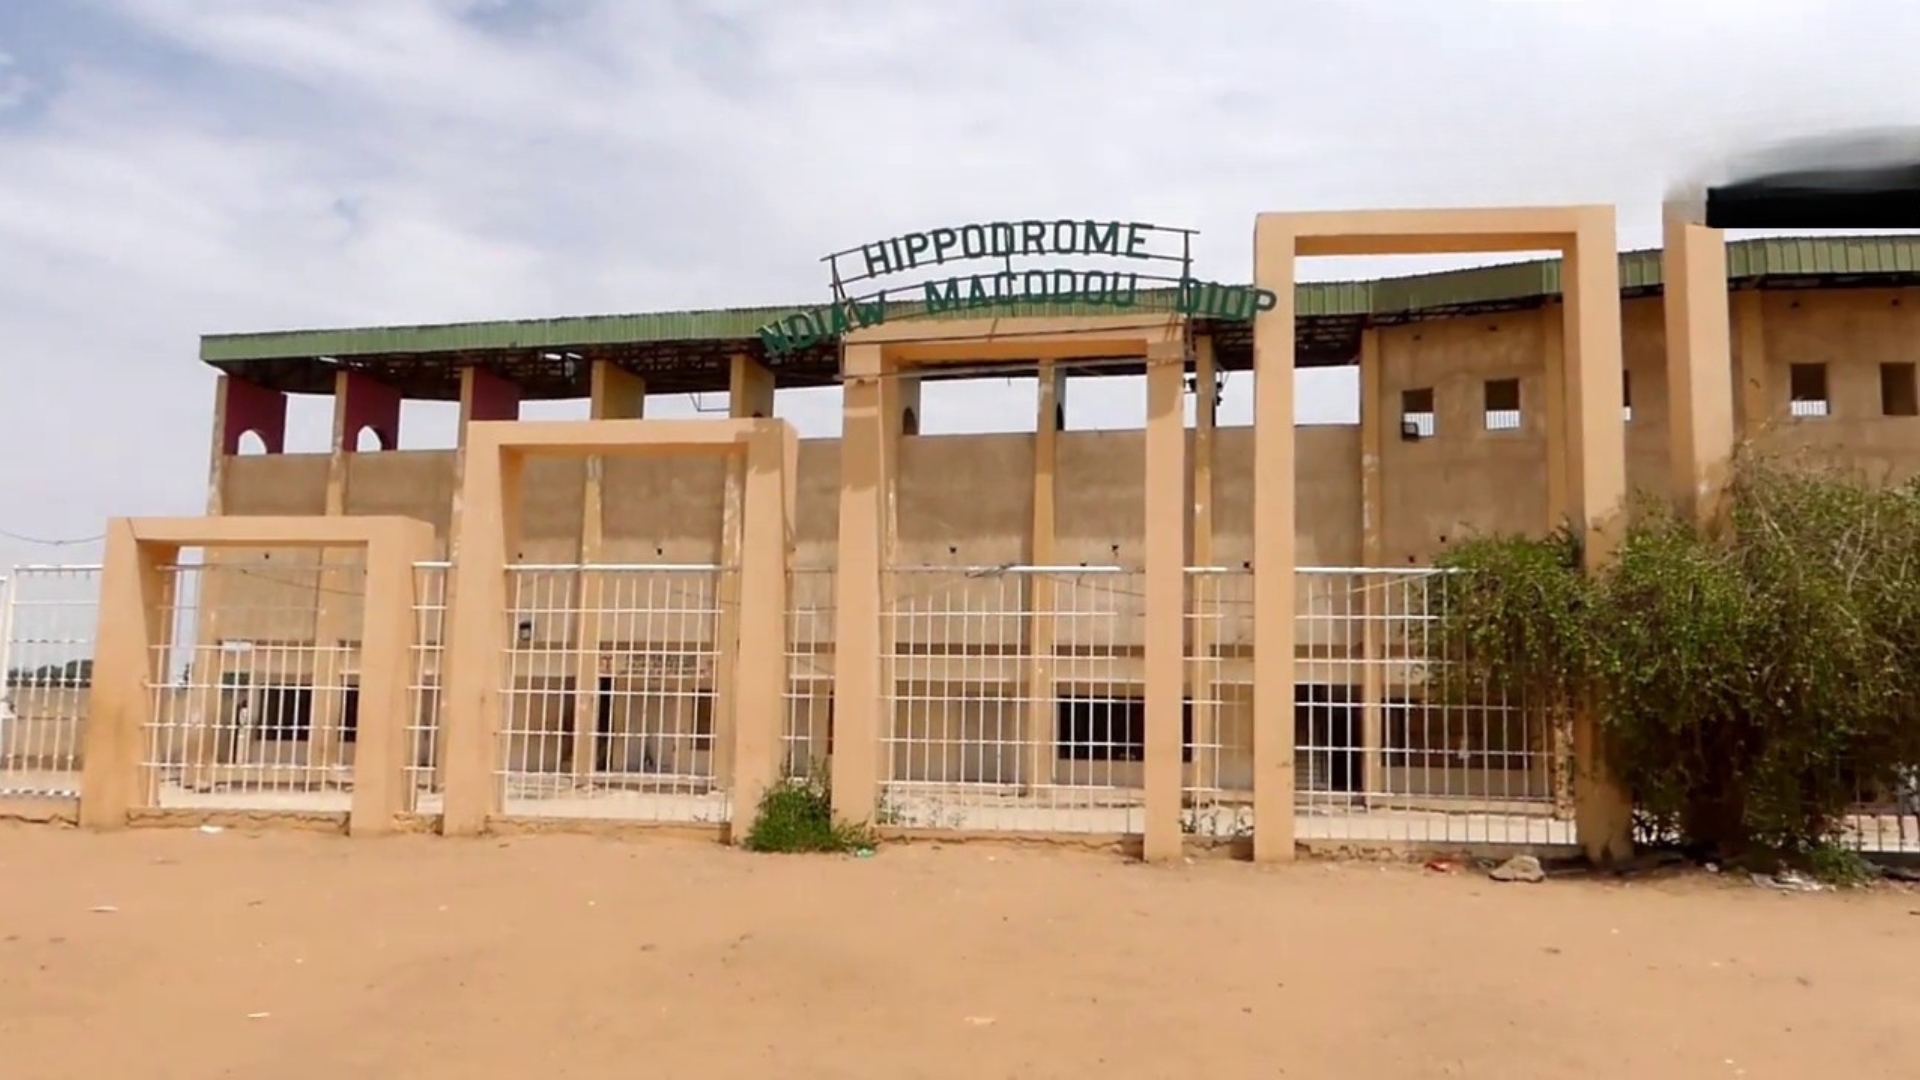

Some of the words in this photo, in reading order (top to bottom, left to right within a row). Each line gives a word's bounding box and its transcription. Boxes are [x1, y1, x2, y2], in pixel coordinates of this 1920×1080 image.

[862, 219, 1154, 278] HIPPODROME
[757, 289, 885, 352] NDIAW
[1176, 277, 1277, 324] DIOP
